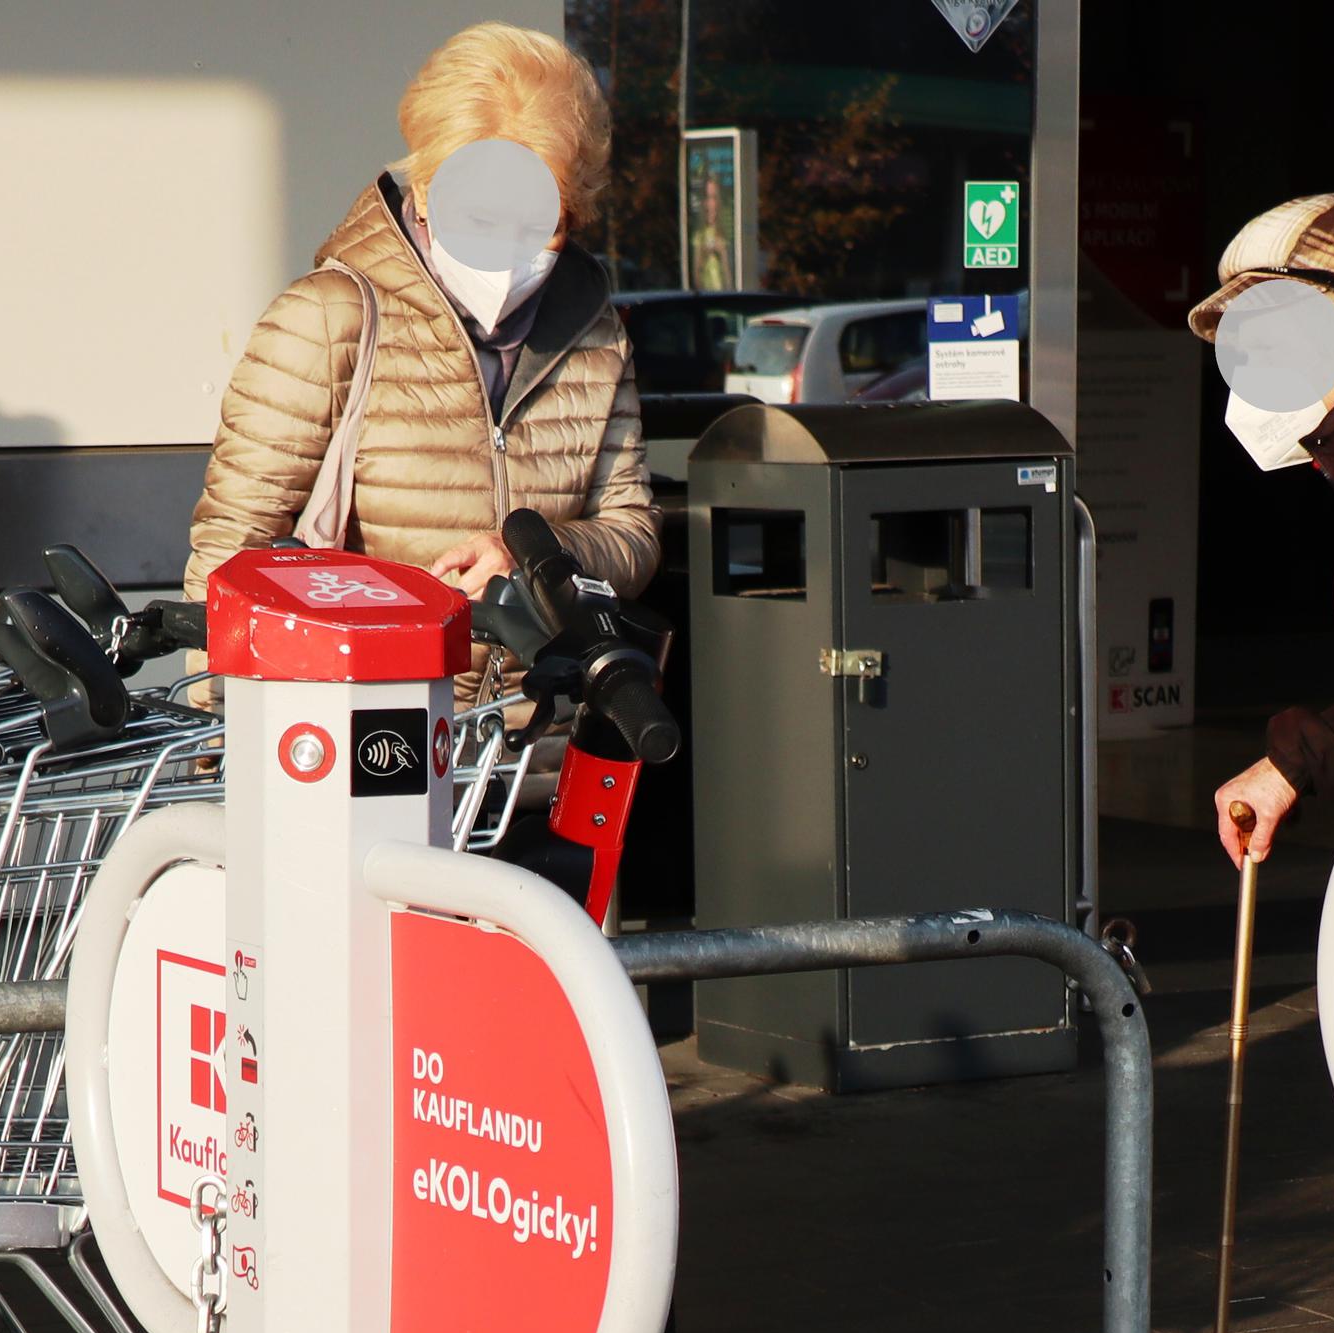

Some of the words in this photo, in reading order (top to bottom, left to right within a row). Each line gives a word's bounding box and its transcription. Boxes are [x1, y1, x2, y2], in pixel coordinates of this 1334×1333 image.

[971, 247, 1011, 266] AED
[1133, 684, 1180, 708] SCAN
[412, 1047, 443, 1085] DO
[412, 1088, 542, 1154] KAUFLANDU
[412, 1158, 598, 1259] eKOLOgicky!
